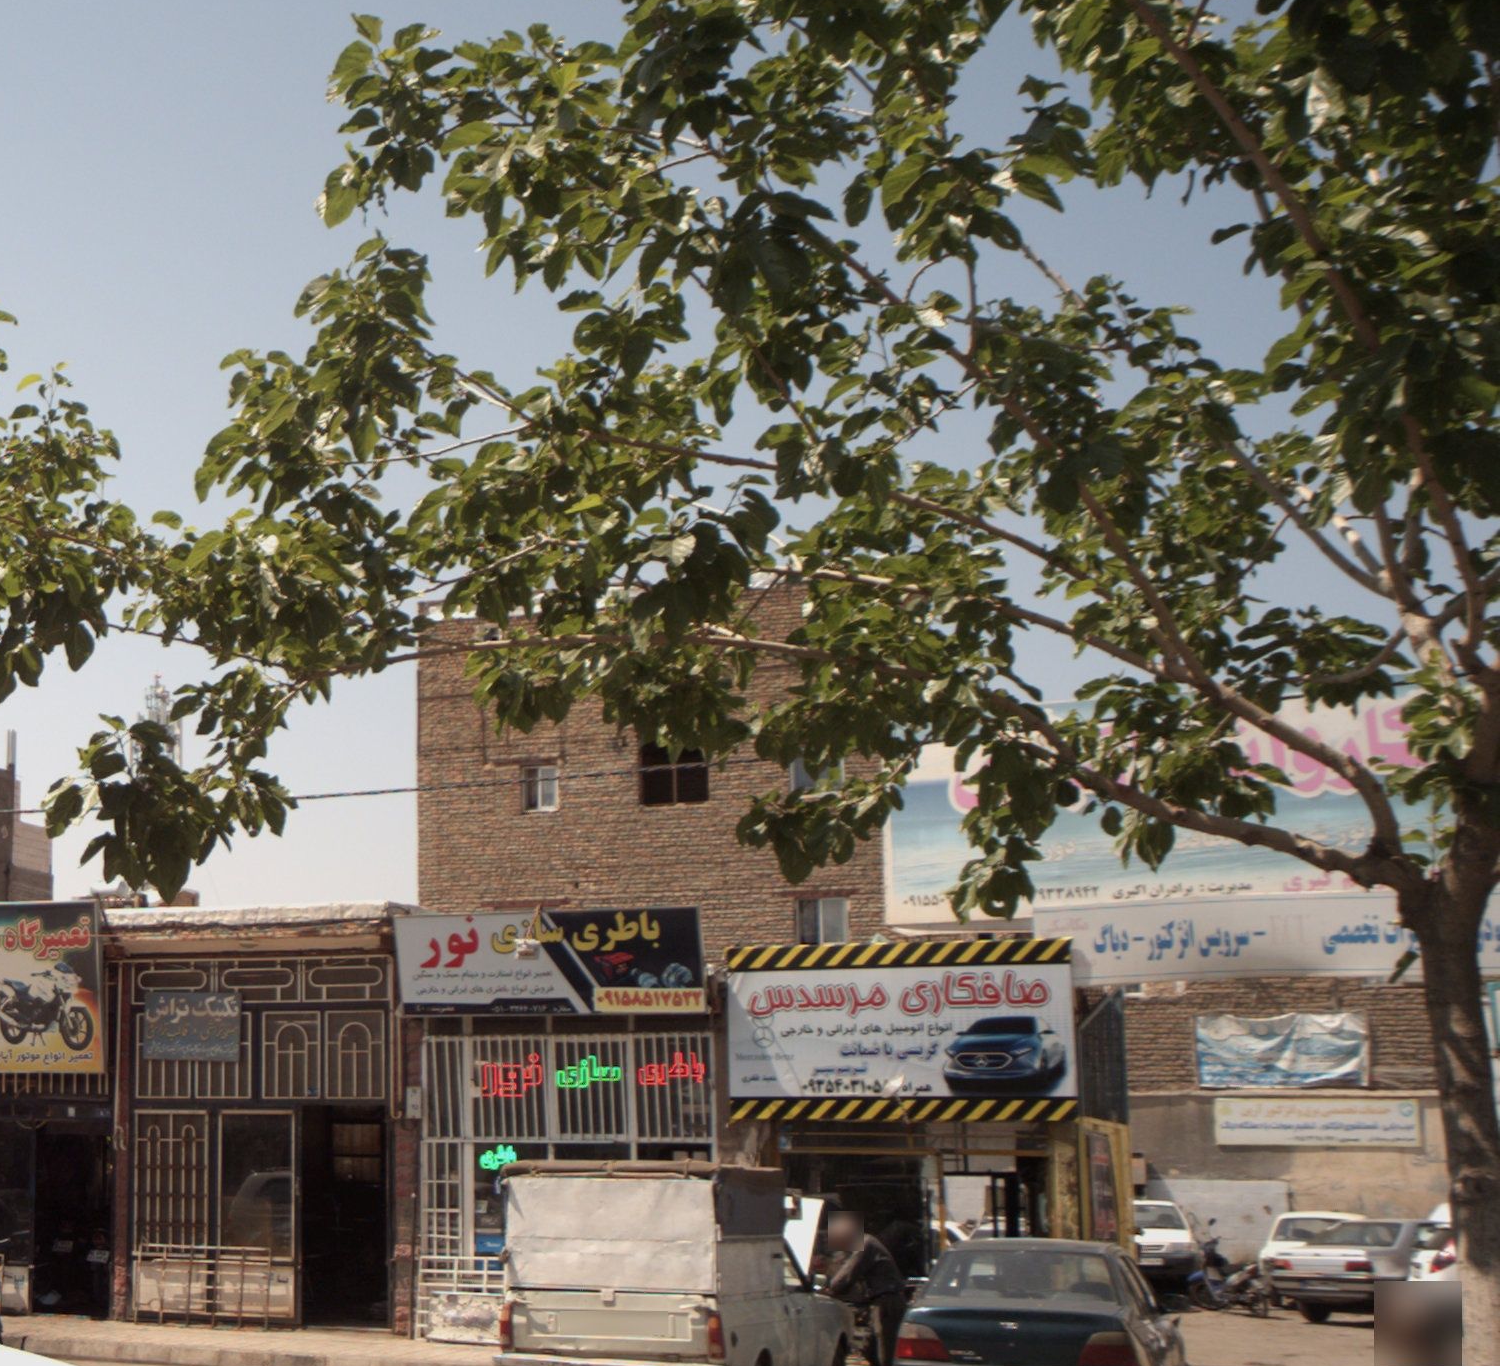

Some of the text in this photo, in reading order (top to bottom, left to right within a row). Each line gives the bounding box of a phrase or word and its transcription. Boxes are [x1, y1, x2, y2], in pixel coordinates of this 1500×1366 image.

[3, 916, 92, 960] تعمیرگاه
[418, 915, 480, 969] نور
[571, 910, 662, 953] باطری
[1093, 922, 1129, 960] دیاگ
[1147, 918, 1195, 961] انژکتور
[1198, 927, 1250, 958] سرویس
[1322, 914, 1380, 955] تخصصی
[145, 995, 190, 1023] تراش
[747, 969, 1051, 1019] صافکاری مرسدس
[859, 1022, 883, 1036] های
[554, 1054, 623, 1090] سازی
[636, 1051, 707, 1087] باطری
[801, 1078, 893, 1095] ۰۹۳۵۴۰۳۱۰۵
